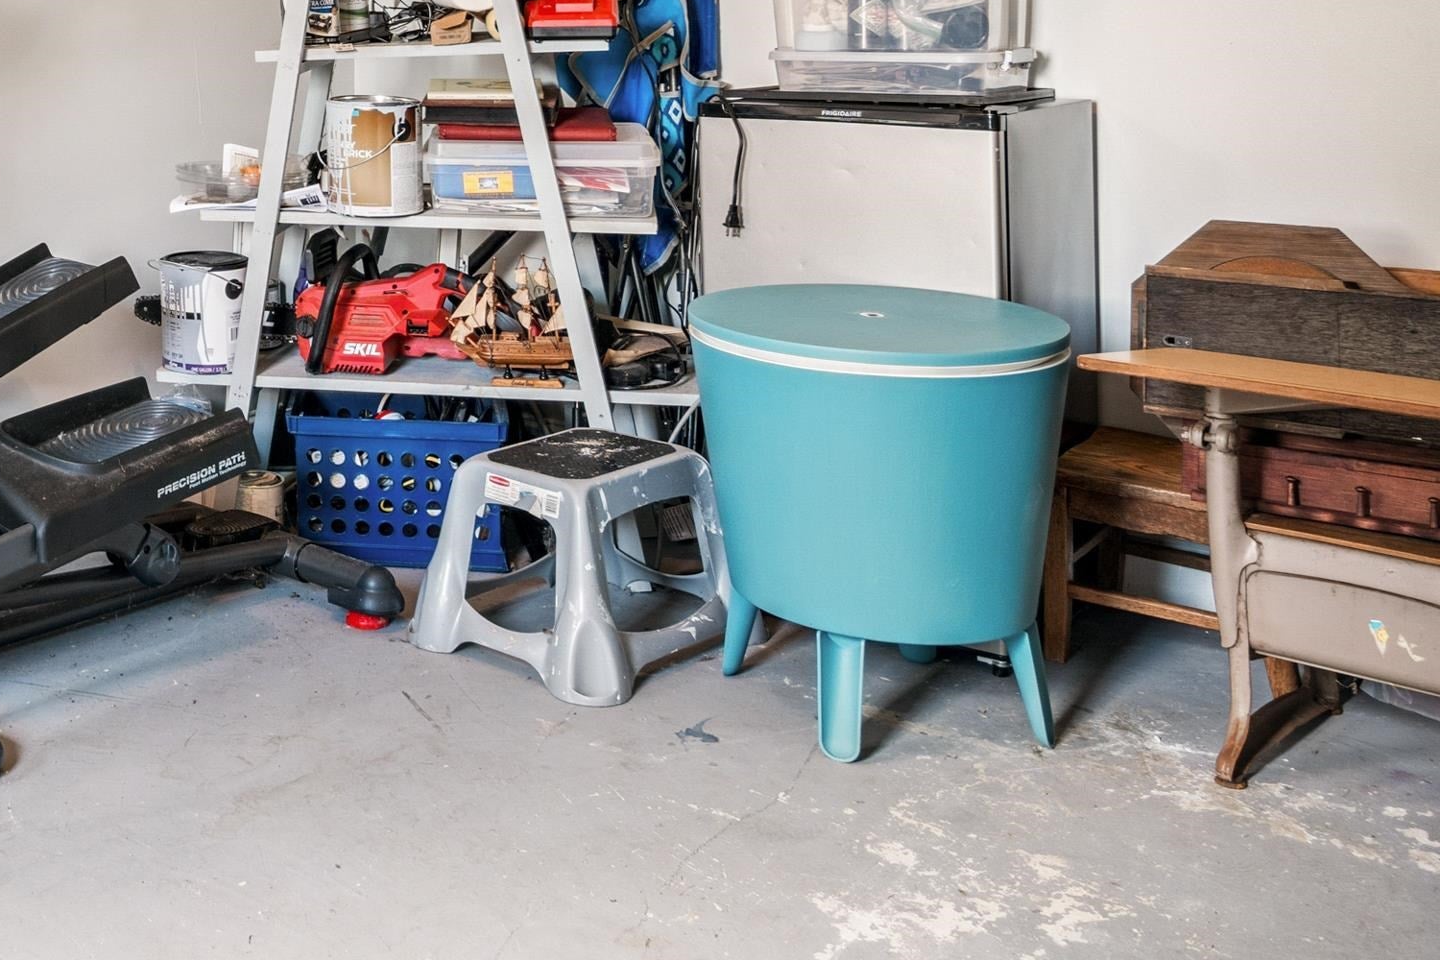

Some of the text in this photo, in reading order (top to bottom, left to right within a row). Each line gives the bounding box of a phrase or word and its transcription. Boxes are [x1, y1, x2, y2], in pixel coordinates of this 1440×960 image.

[821, 110, 863, 118] FRIGIDAIRE
[343, 342, 381, 357] SKIL
[156, 451, 246, 500] PRECISION PATH
[201, 472, 219, 485] Motion
[220, 460, 248, 477] Technology
